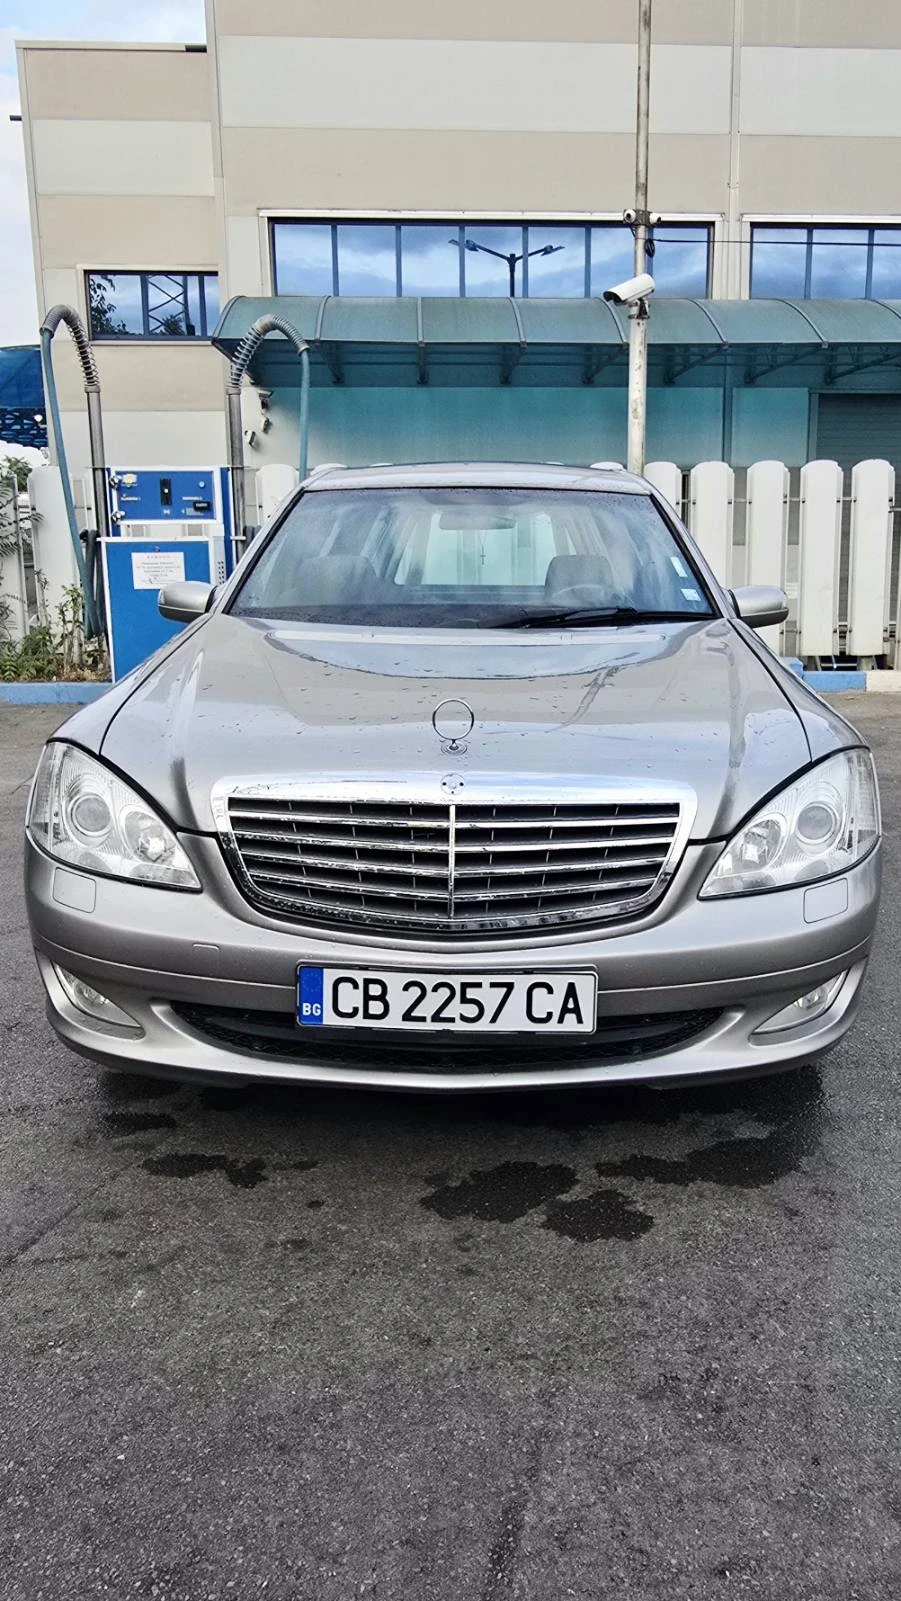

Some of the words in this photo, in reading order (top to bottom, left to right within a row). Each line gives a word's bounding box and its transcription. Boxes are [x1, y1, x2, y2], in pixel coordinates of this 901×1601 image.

[302, 1002, 322, 1016] BG
[331, 976, 390, 1020] CB
[401, 980, 515, 1023] 2257
[525, 981, 584, 1024] CA
